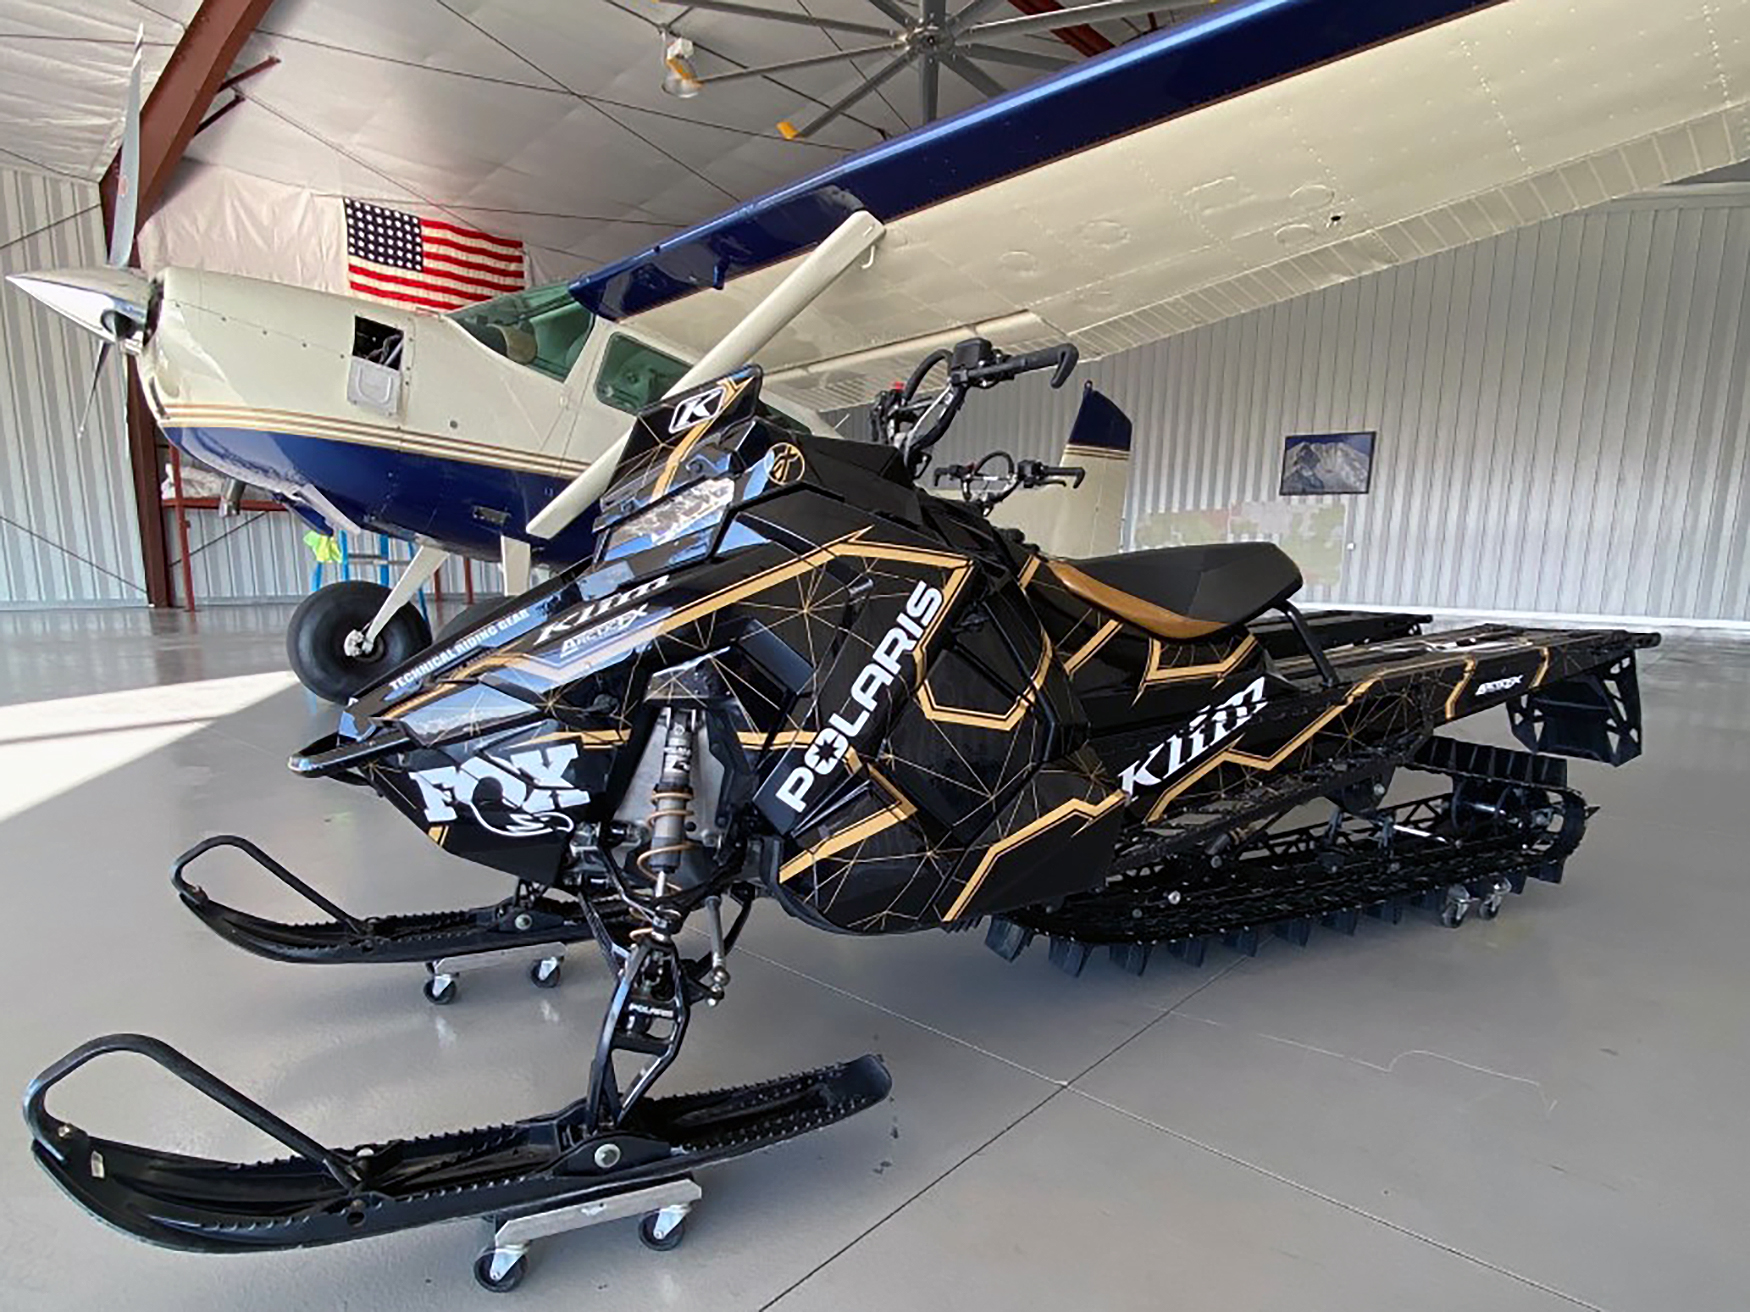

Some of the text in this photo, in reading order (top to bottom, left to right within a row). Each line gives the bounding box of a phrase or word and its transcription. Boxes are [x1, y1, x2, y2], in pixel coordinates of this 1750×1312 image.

[388, 648, 457, 691] TECHNICAL
[454, 623, 499, 656] RIDING
[498, 609, 530, 632] GEAR
[775, 579, 944, 813] POLARIS
[408, 743, 592, 826] FOX
